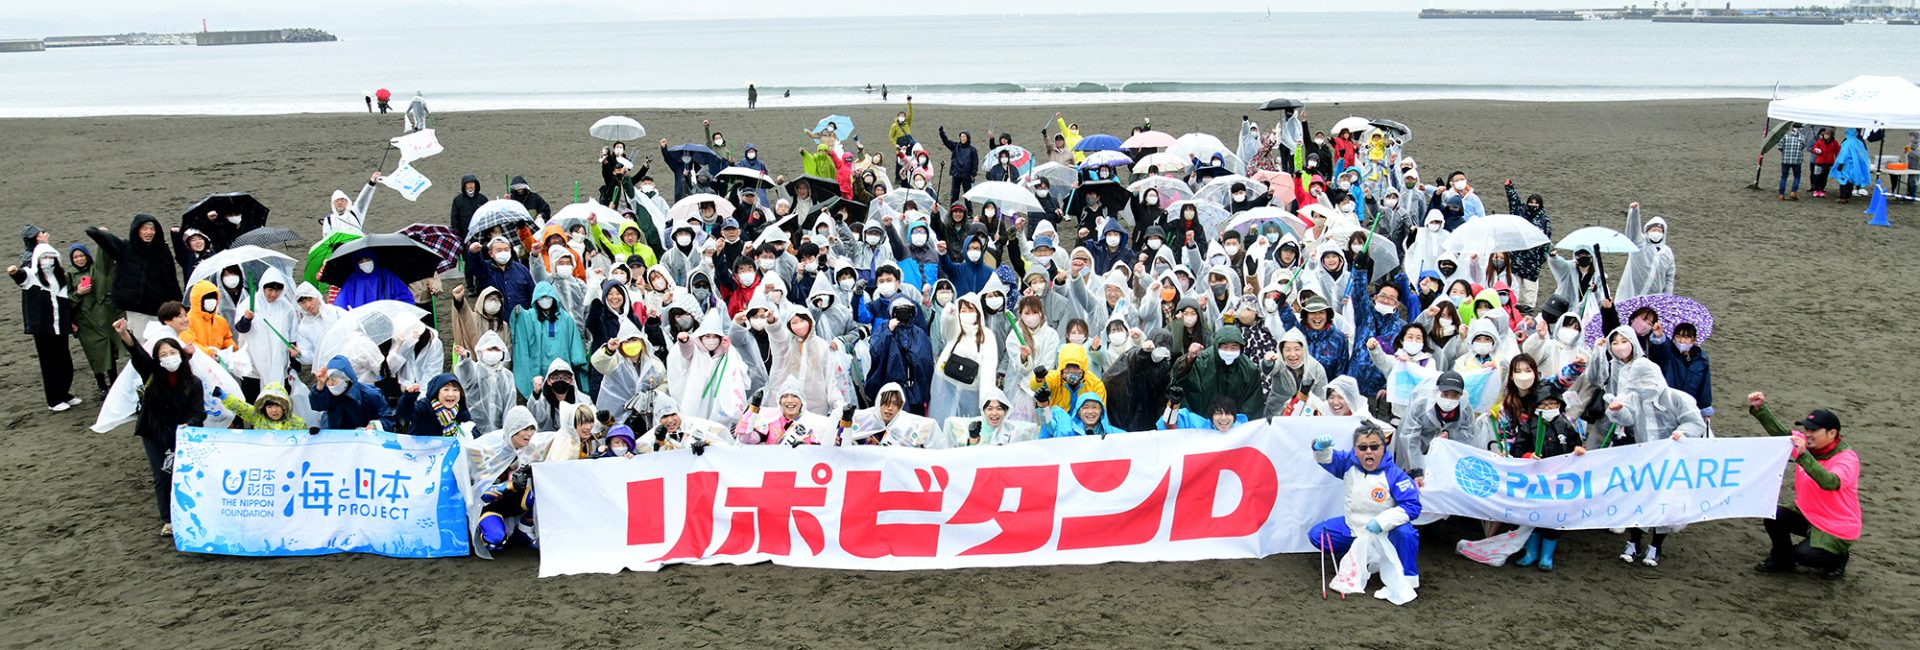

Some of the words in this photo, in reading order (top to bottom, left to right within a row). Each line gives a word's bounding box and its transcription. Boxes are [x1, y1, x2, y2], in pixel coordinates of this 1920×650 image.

[248, 468, 276, 481] 日本
[1506, 470, 1593, 500] PADI
[1602, 458, 1745, 496] AWARE
[282, 461, 412, 517] 海と日本
[1374, 491, 1384, 499] 76
[222, 498, 238, 507] THE
[239, 498, 275, 508] NIPPON
[338, 503, 409, 520] PROJECT
[626, 446, 1279, 563] リポビタンD
[1504, 495, 1731, 523] FOUNDATION
[221, 508, 275, 518] FOUNDATION
